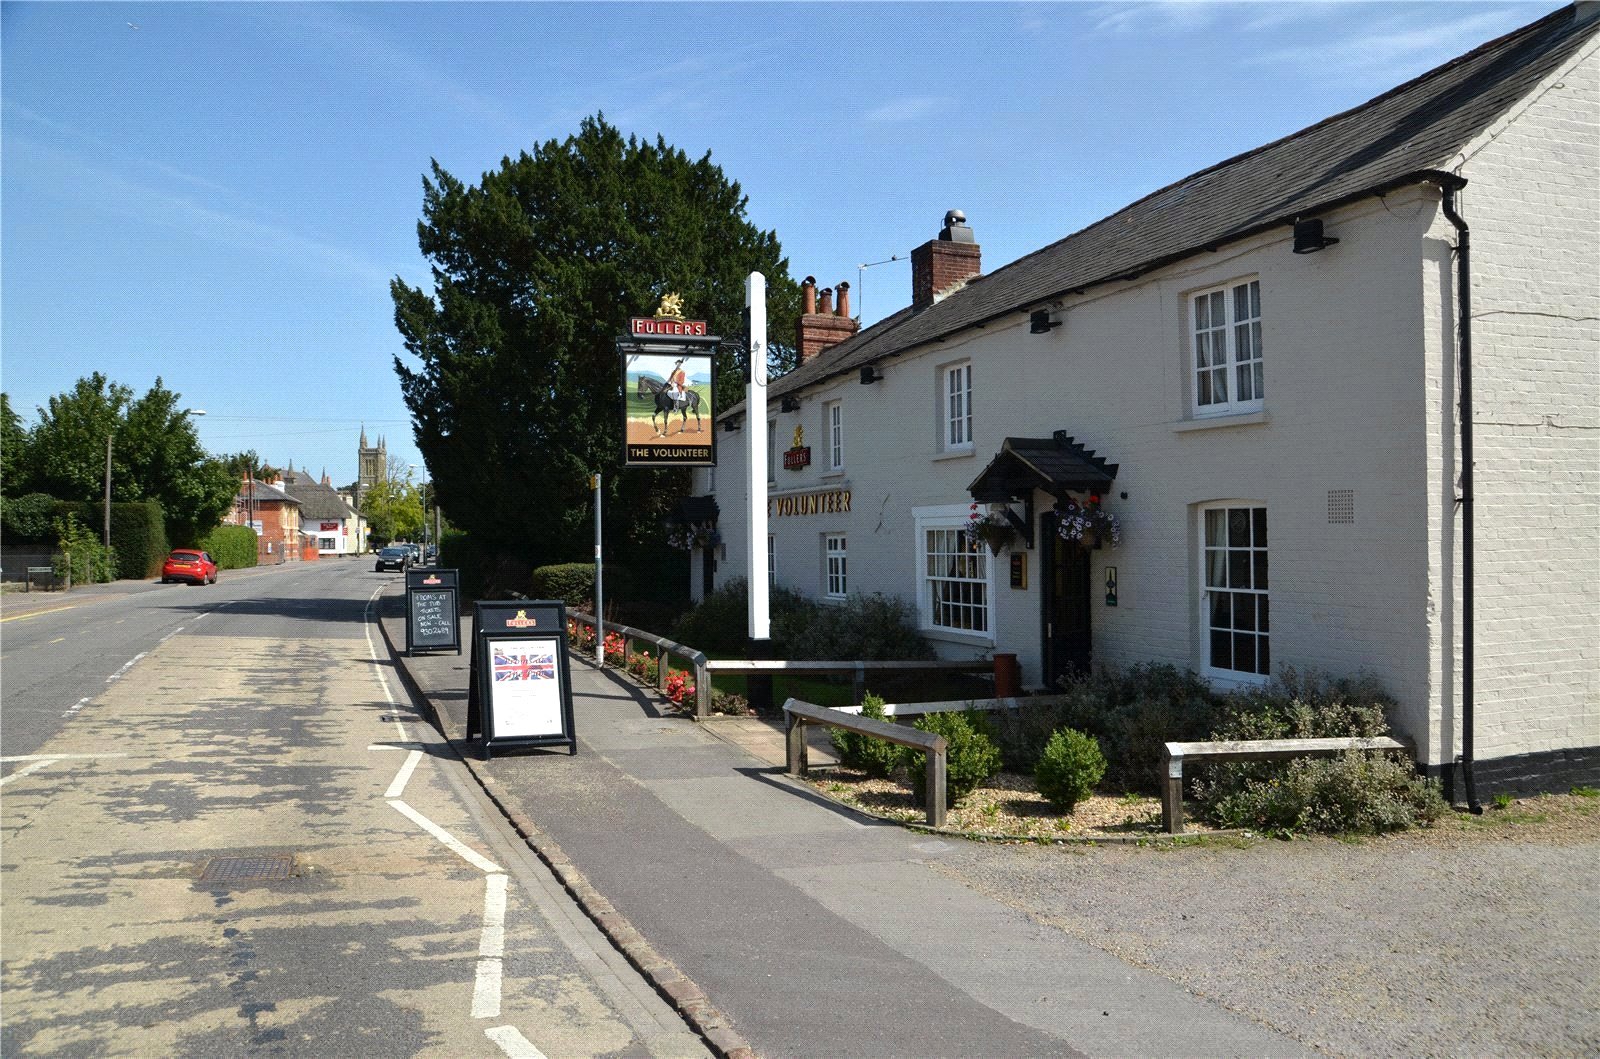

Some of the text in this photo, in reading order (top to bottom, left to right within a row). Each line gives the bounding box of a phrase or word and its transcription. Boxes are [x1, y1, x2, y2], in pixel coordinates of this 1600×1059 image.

[636, 320, 702, 335] FULLER'S
[630, 448, 709, 457] THE VOLUNTEER
[776, 490, 851, 516] VOLUNTEER
